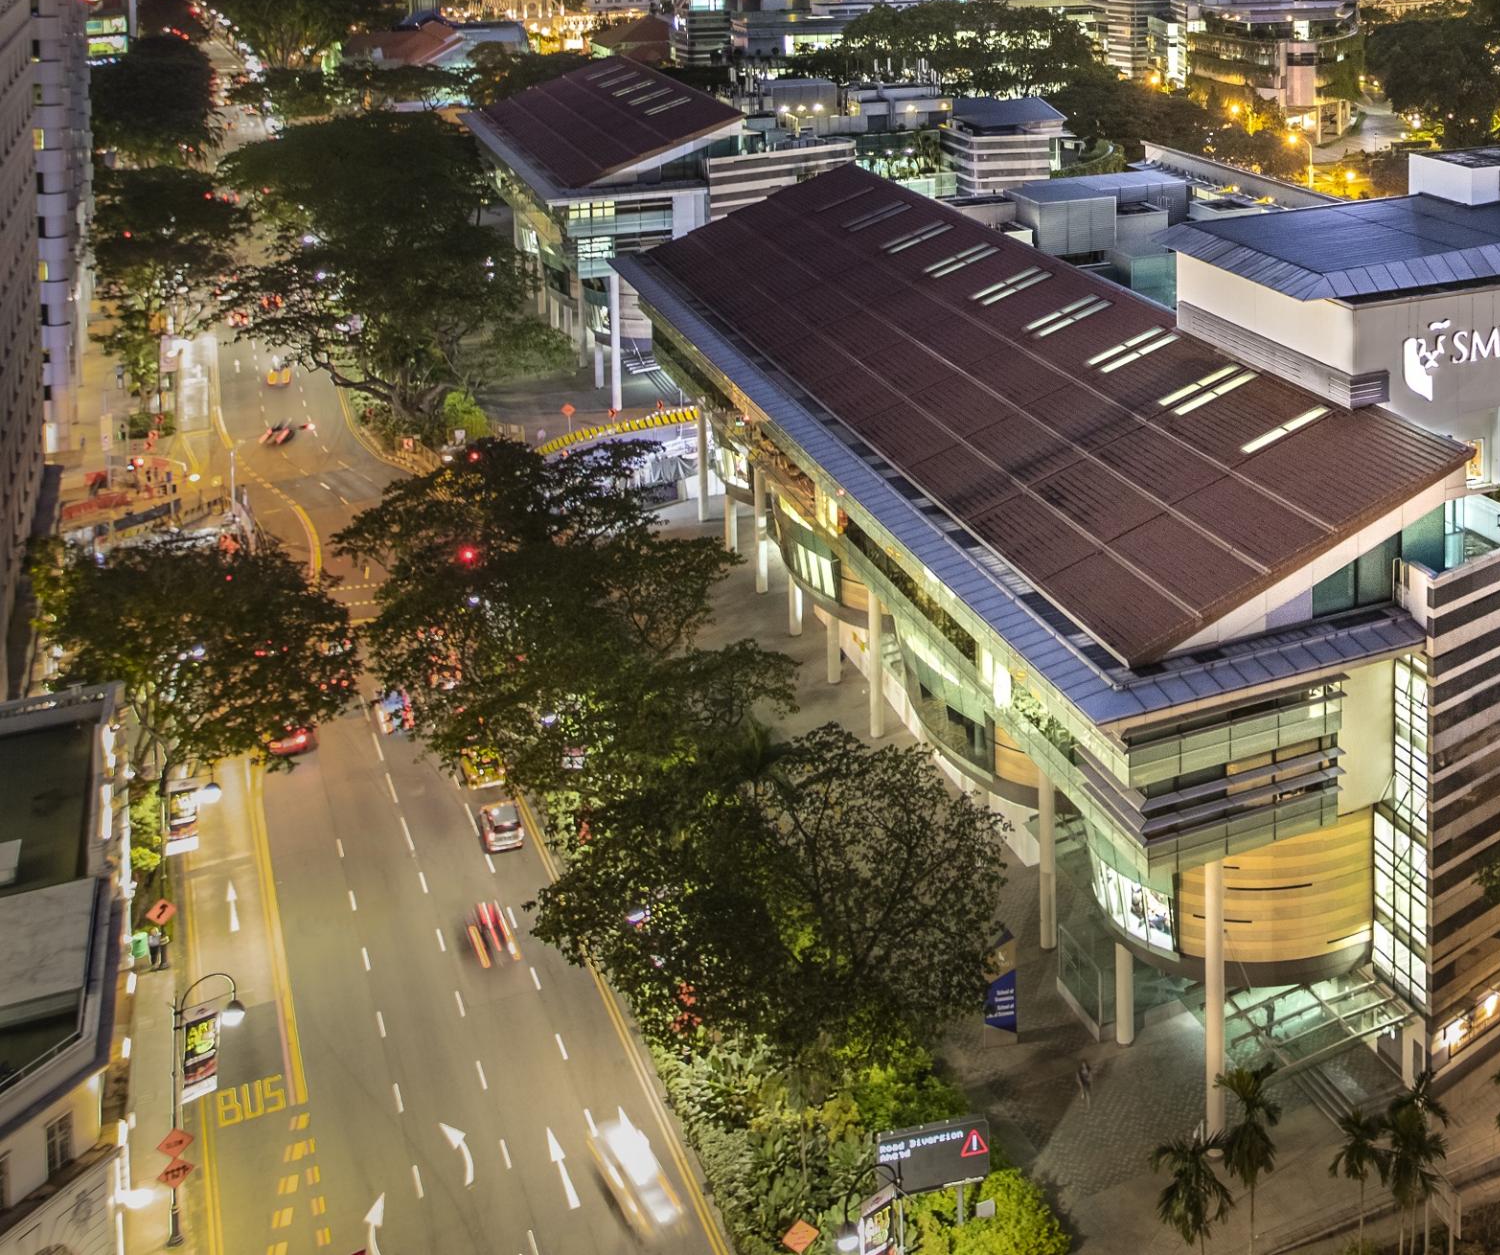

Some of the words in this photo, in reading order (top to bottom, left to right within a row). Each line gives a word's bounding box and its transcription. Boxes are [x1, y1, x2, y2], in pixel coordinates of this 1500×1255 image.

[217, 1074, 287, 1128] BUS
[879, 1141, 905, 1154] Road
[908, 1129, 965, 1149] Diversion
